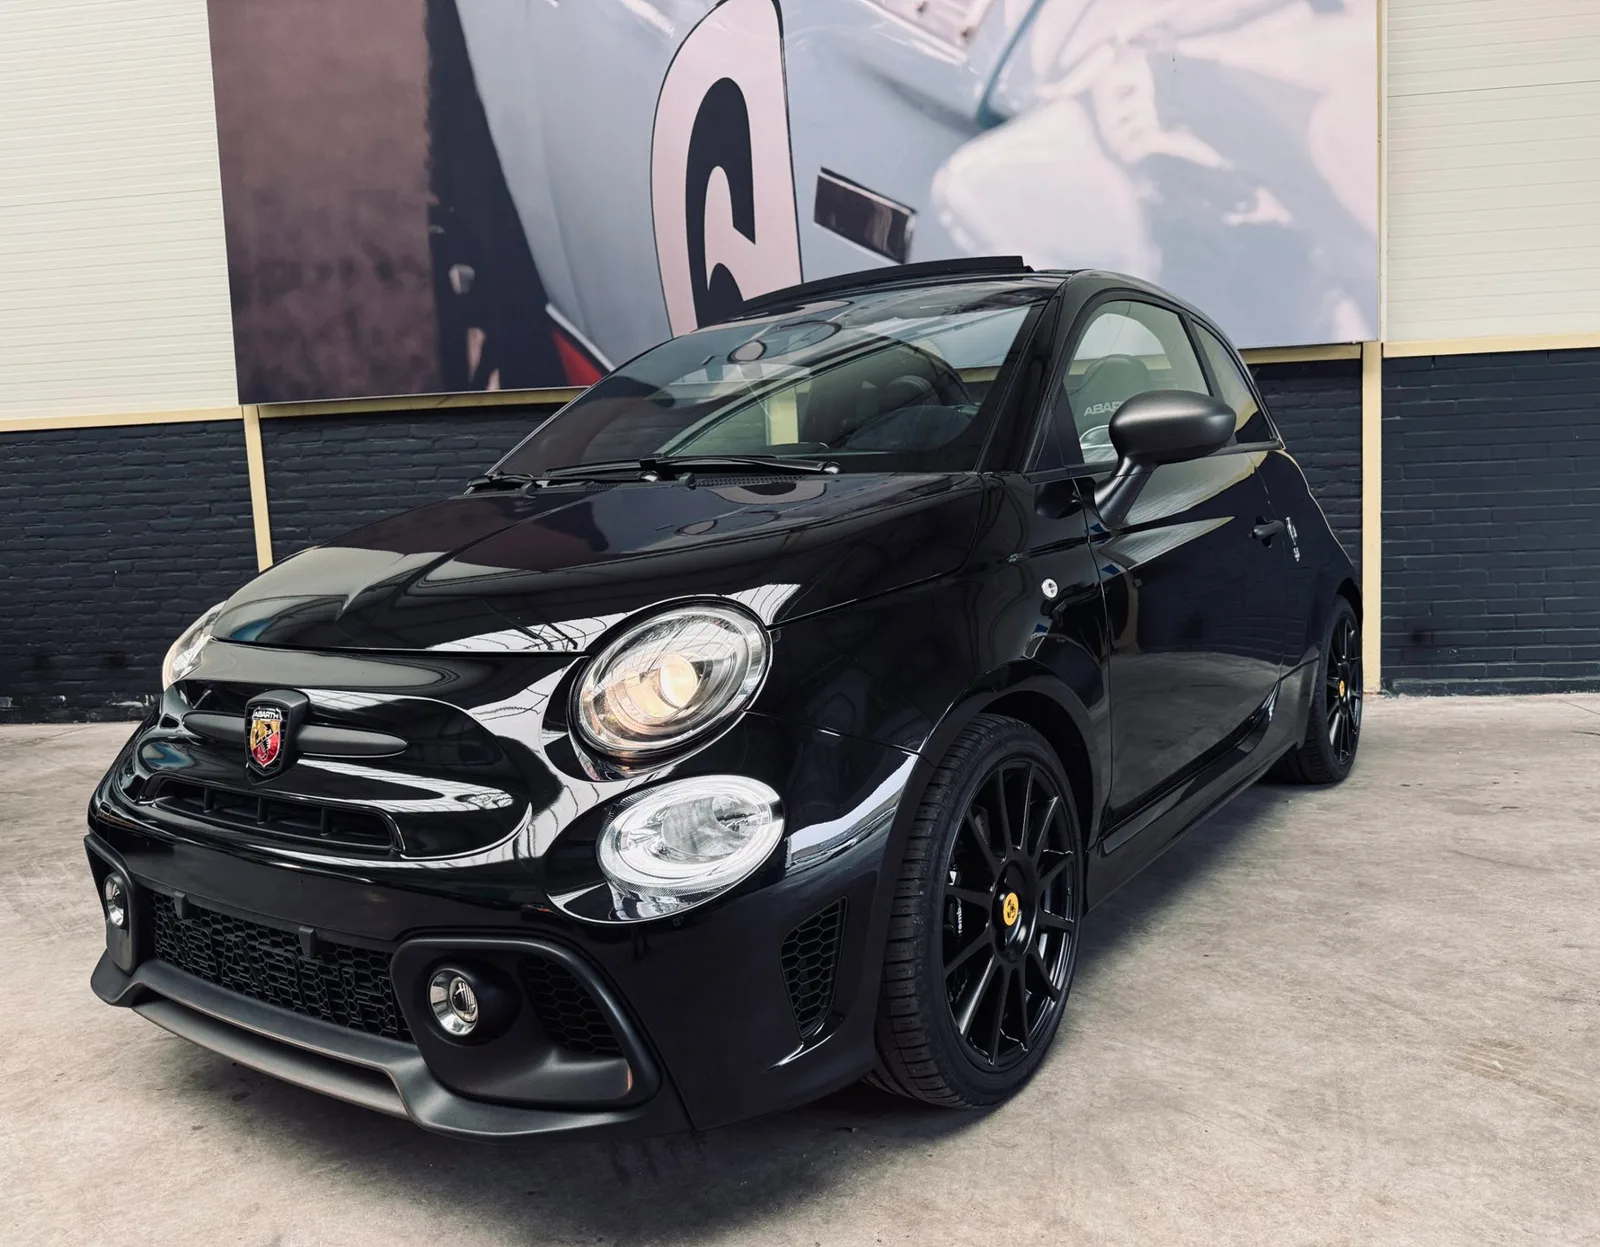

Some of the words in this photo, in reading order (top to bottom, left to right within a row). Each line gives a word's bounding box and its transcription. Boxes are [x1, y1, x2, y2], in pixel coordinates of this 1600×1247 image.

[1084, 401, 1124, 416] ABAR
[253, 710, 279, 719] ABARTH
[155, 911, 398, 1033] ABARTH
